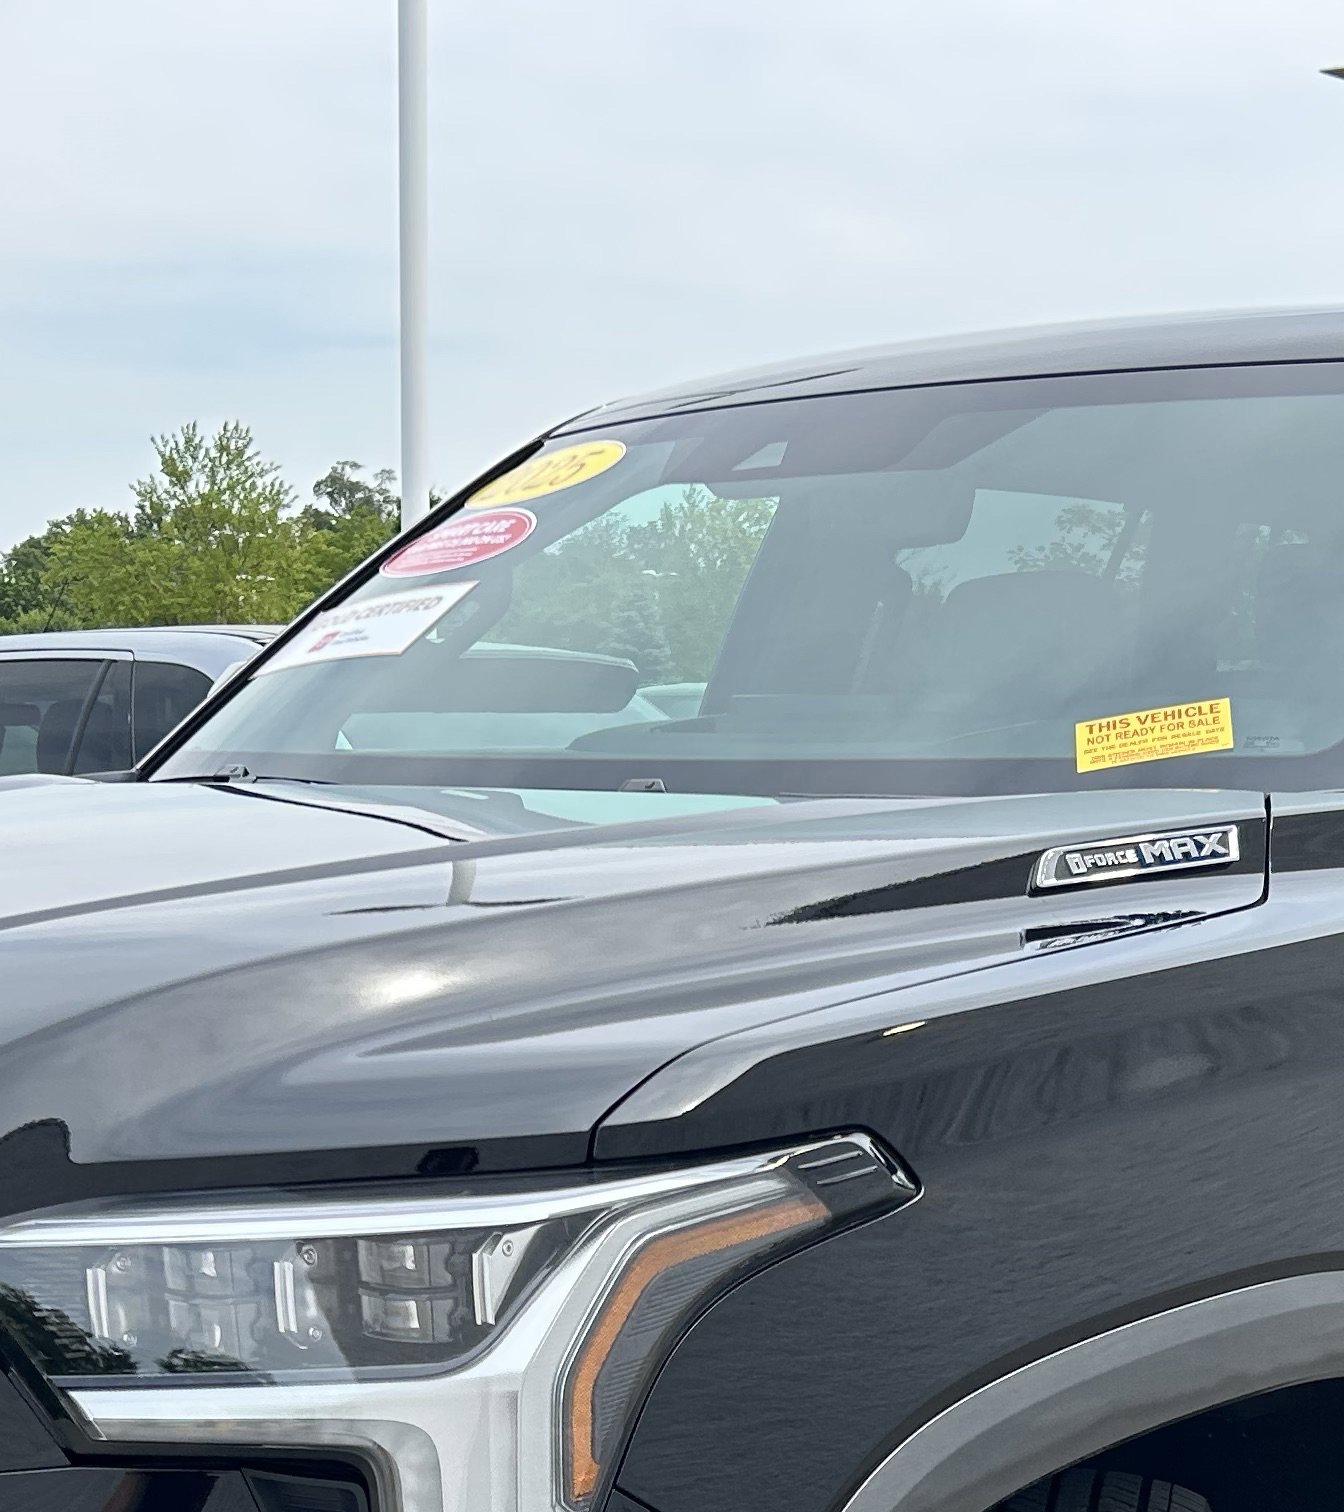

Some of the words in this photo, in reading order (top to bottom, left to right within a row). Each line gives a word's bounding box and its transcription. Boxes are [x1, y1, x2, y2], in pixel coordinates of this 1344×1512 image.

[1085, 717, 1131, 735] THIS
[1136, 702, 1222, 726] VEHICLE
[1087, 733, 1111, 746] NOT
[1116, 725, 1156, 741] READY
[1160, 721, 1185, 733] FOR
[1188, 716, 1221, 729] SALE
[1139, 833, 1230, 864] MAX
